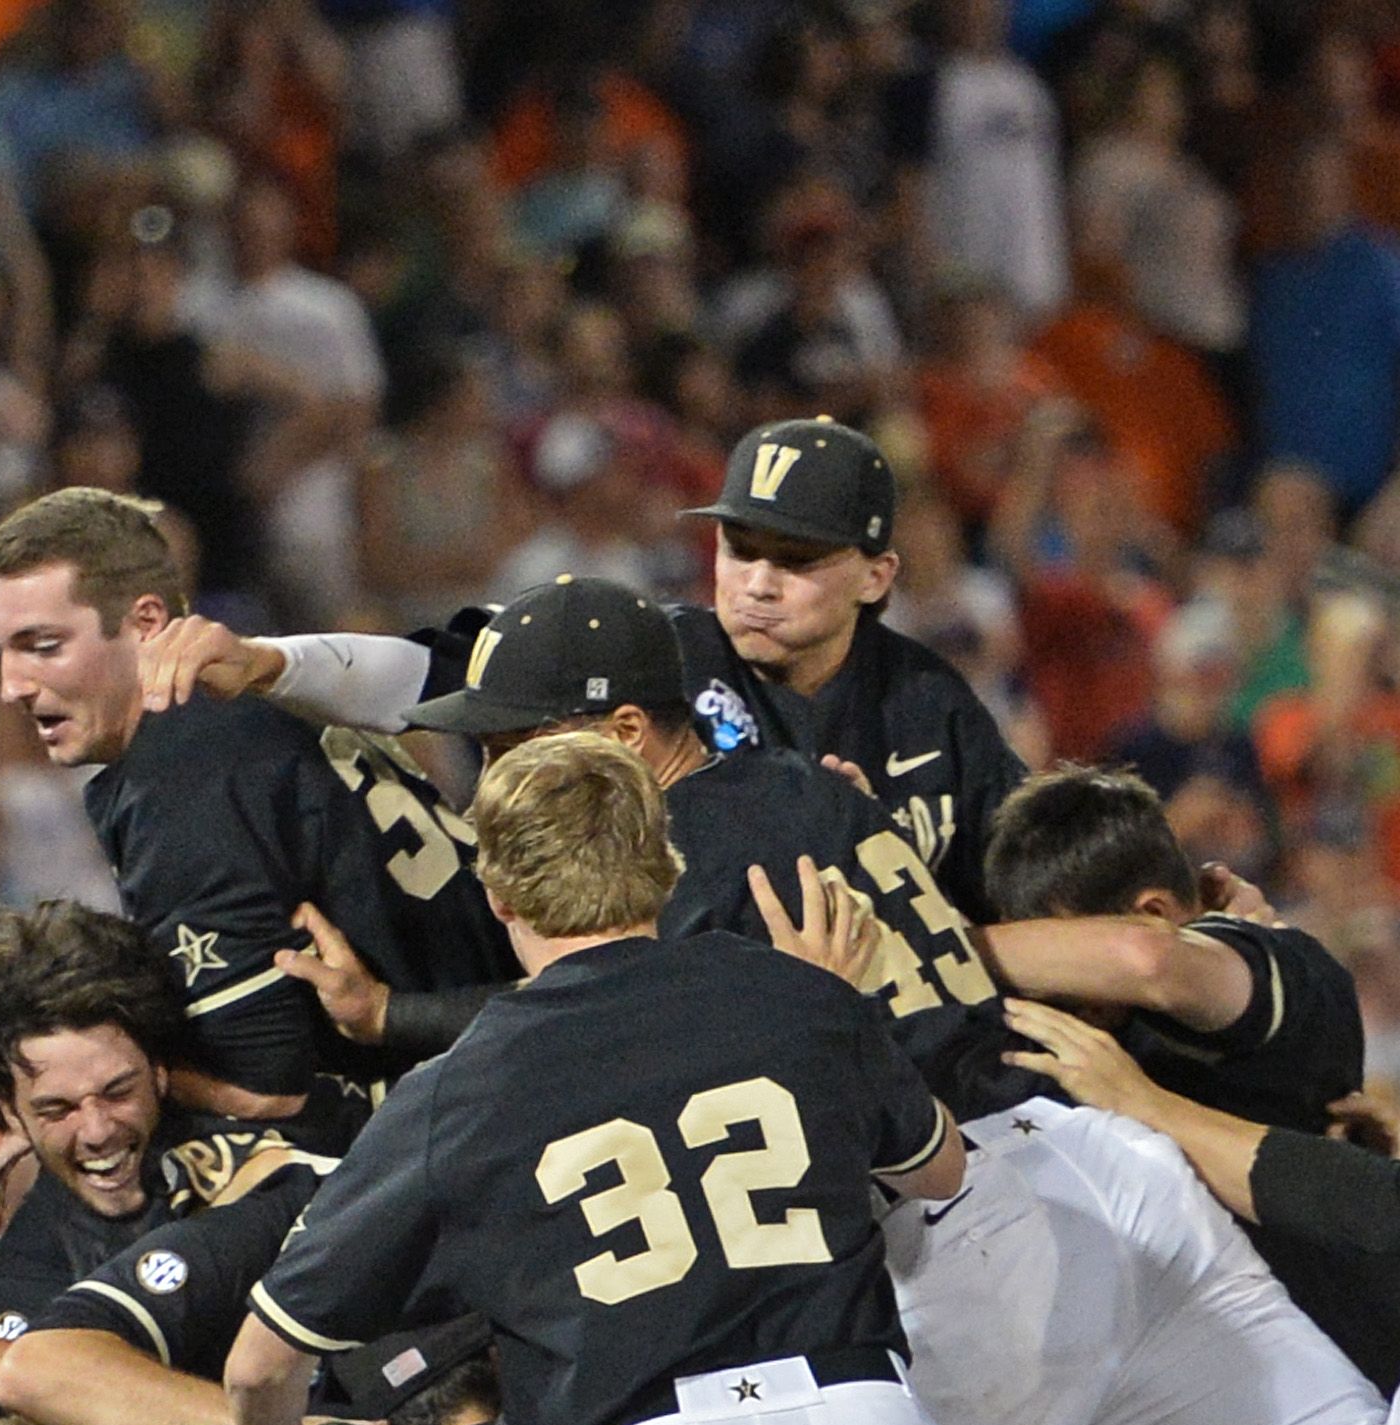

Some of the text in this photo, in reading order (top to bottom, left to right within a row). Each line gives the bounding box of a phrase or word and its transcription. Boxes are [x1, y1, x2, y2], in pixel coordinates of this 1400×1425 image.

[750, 443, 801, 501] V
[319, 724, 480, 901] 3
[535, 1076, 833, 1305] 32
